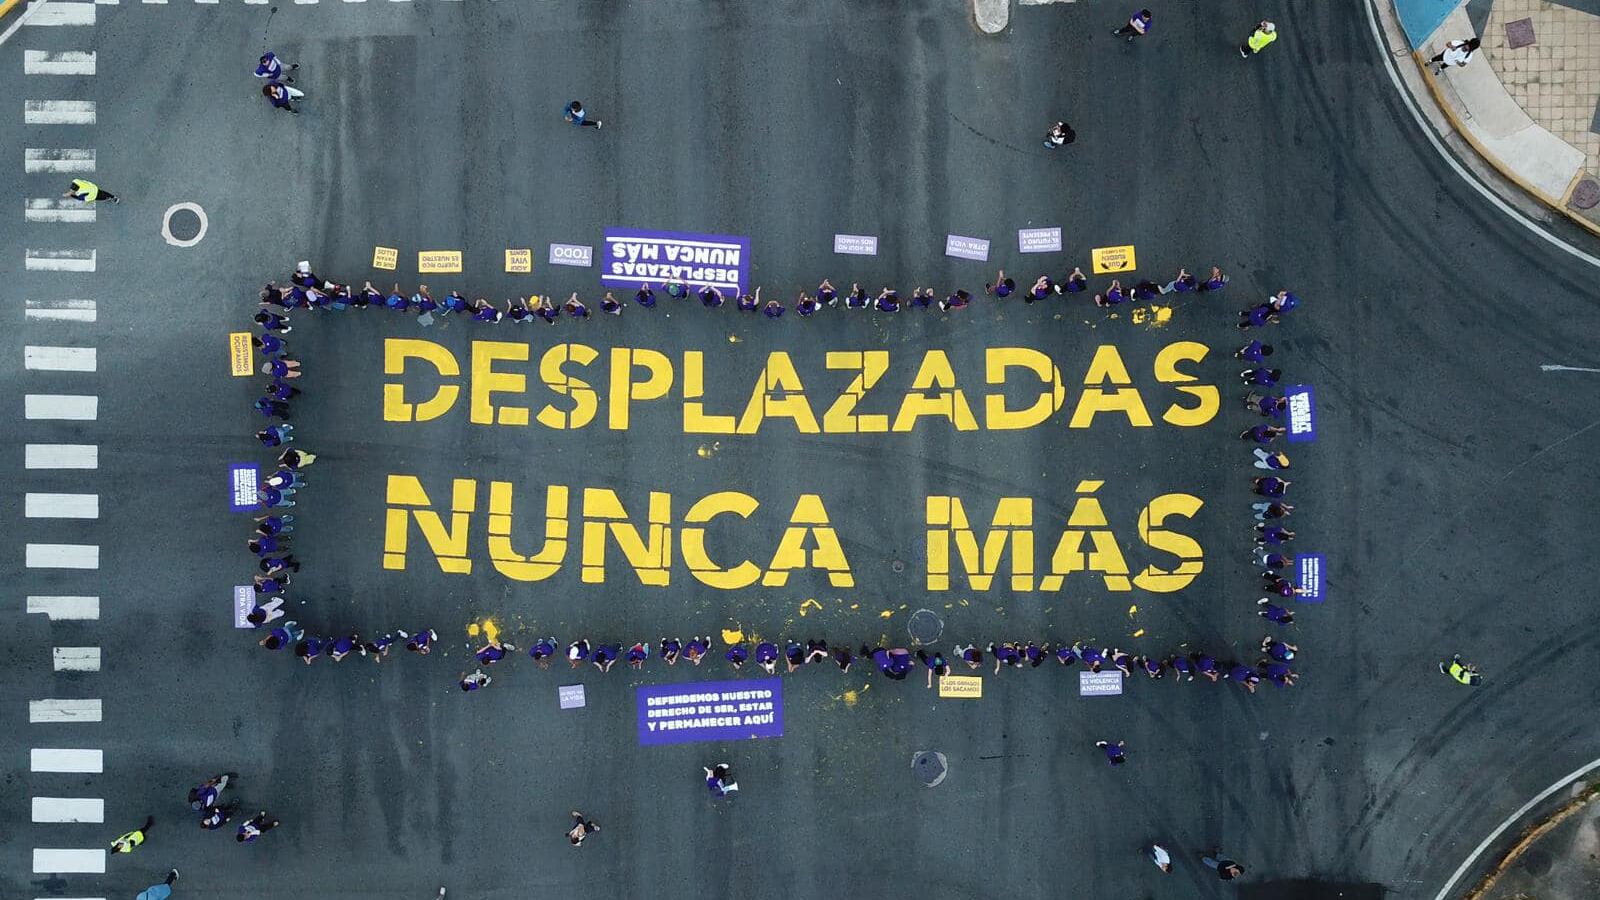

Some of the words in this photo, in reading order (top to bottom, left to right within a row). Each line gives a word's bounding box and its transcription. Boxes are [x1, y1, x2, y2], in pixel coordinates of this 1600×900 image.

[554, 248, 589, 258] TODO
[612, 243, 658, 263] MÁS
[665, 245, 740, 265] NUNCA
[612, 262, 738, 281] DESPLAZADAS
[384, 339, 1219, 434] DESPLAZADAS
[384, 475, 854, 589] NUNCA
[928, 481, 1203, 592] MÁS
[647, 693, 719, 706] DEFENDEMOS
[722, 690, 771, 701] NUESTRO
[648, 706, 695, 718] DERECHO
[698, 706, 711, 714] DE
[714, 705, 737, 713] SER,
[740, 702, 773, 711] ESTAR
[648, 722, 657, 731] Y
[660, 717, 741, 731] PERMANECER
[744, 712, 774, 725] AQUÍ
